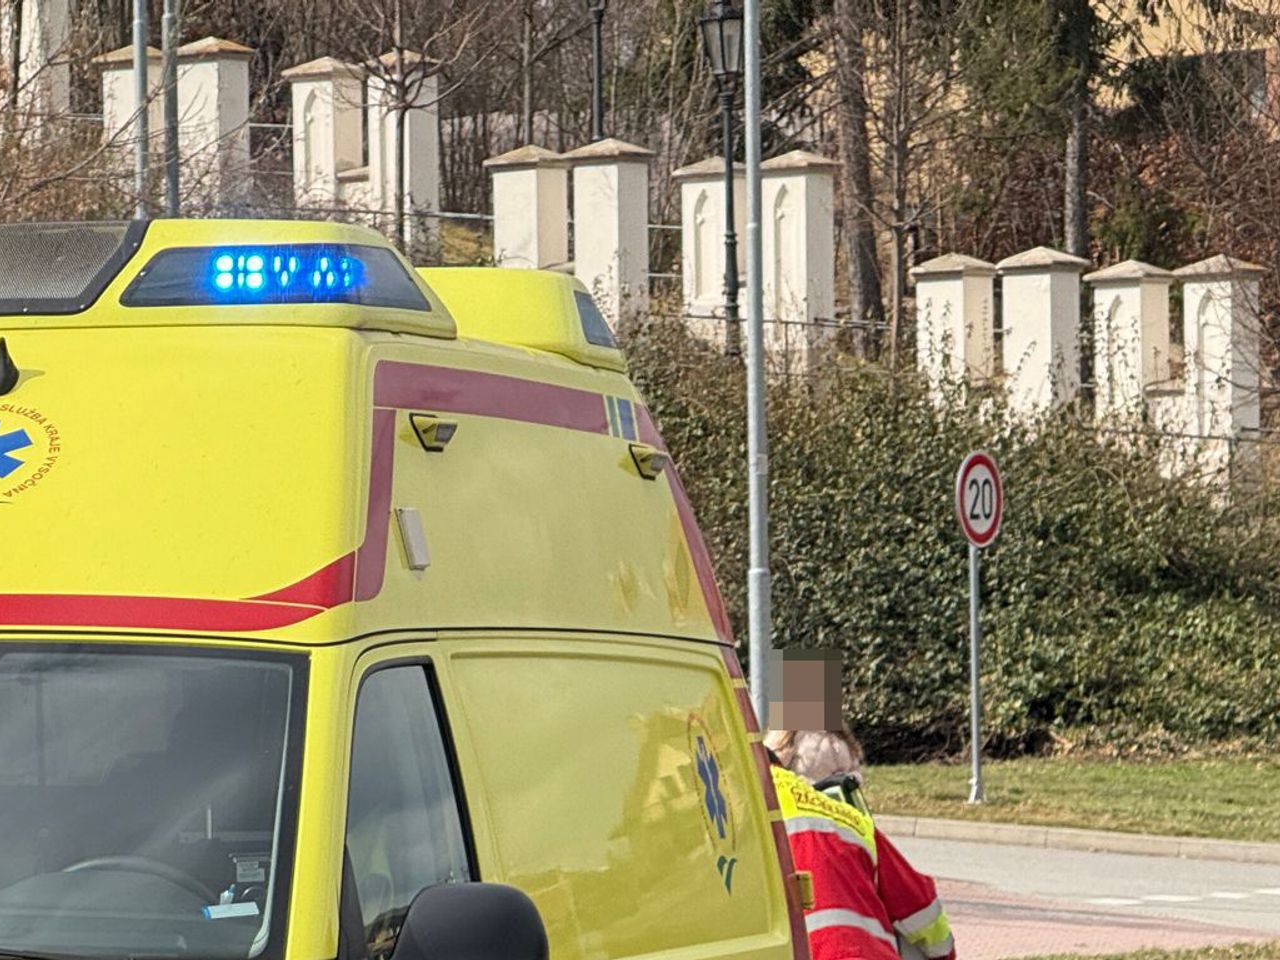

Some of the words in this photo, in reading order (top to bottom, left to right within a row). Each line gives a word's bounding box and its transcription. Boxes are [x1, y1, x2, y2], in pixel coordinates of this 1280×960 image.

[0, 403, 47, 426] SLUŽBA
[43, 424, 61, 453] KRAJE
[3, 455, 60, 498] VYSOČINA
[968, 478, 993, 520] 20
